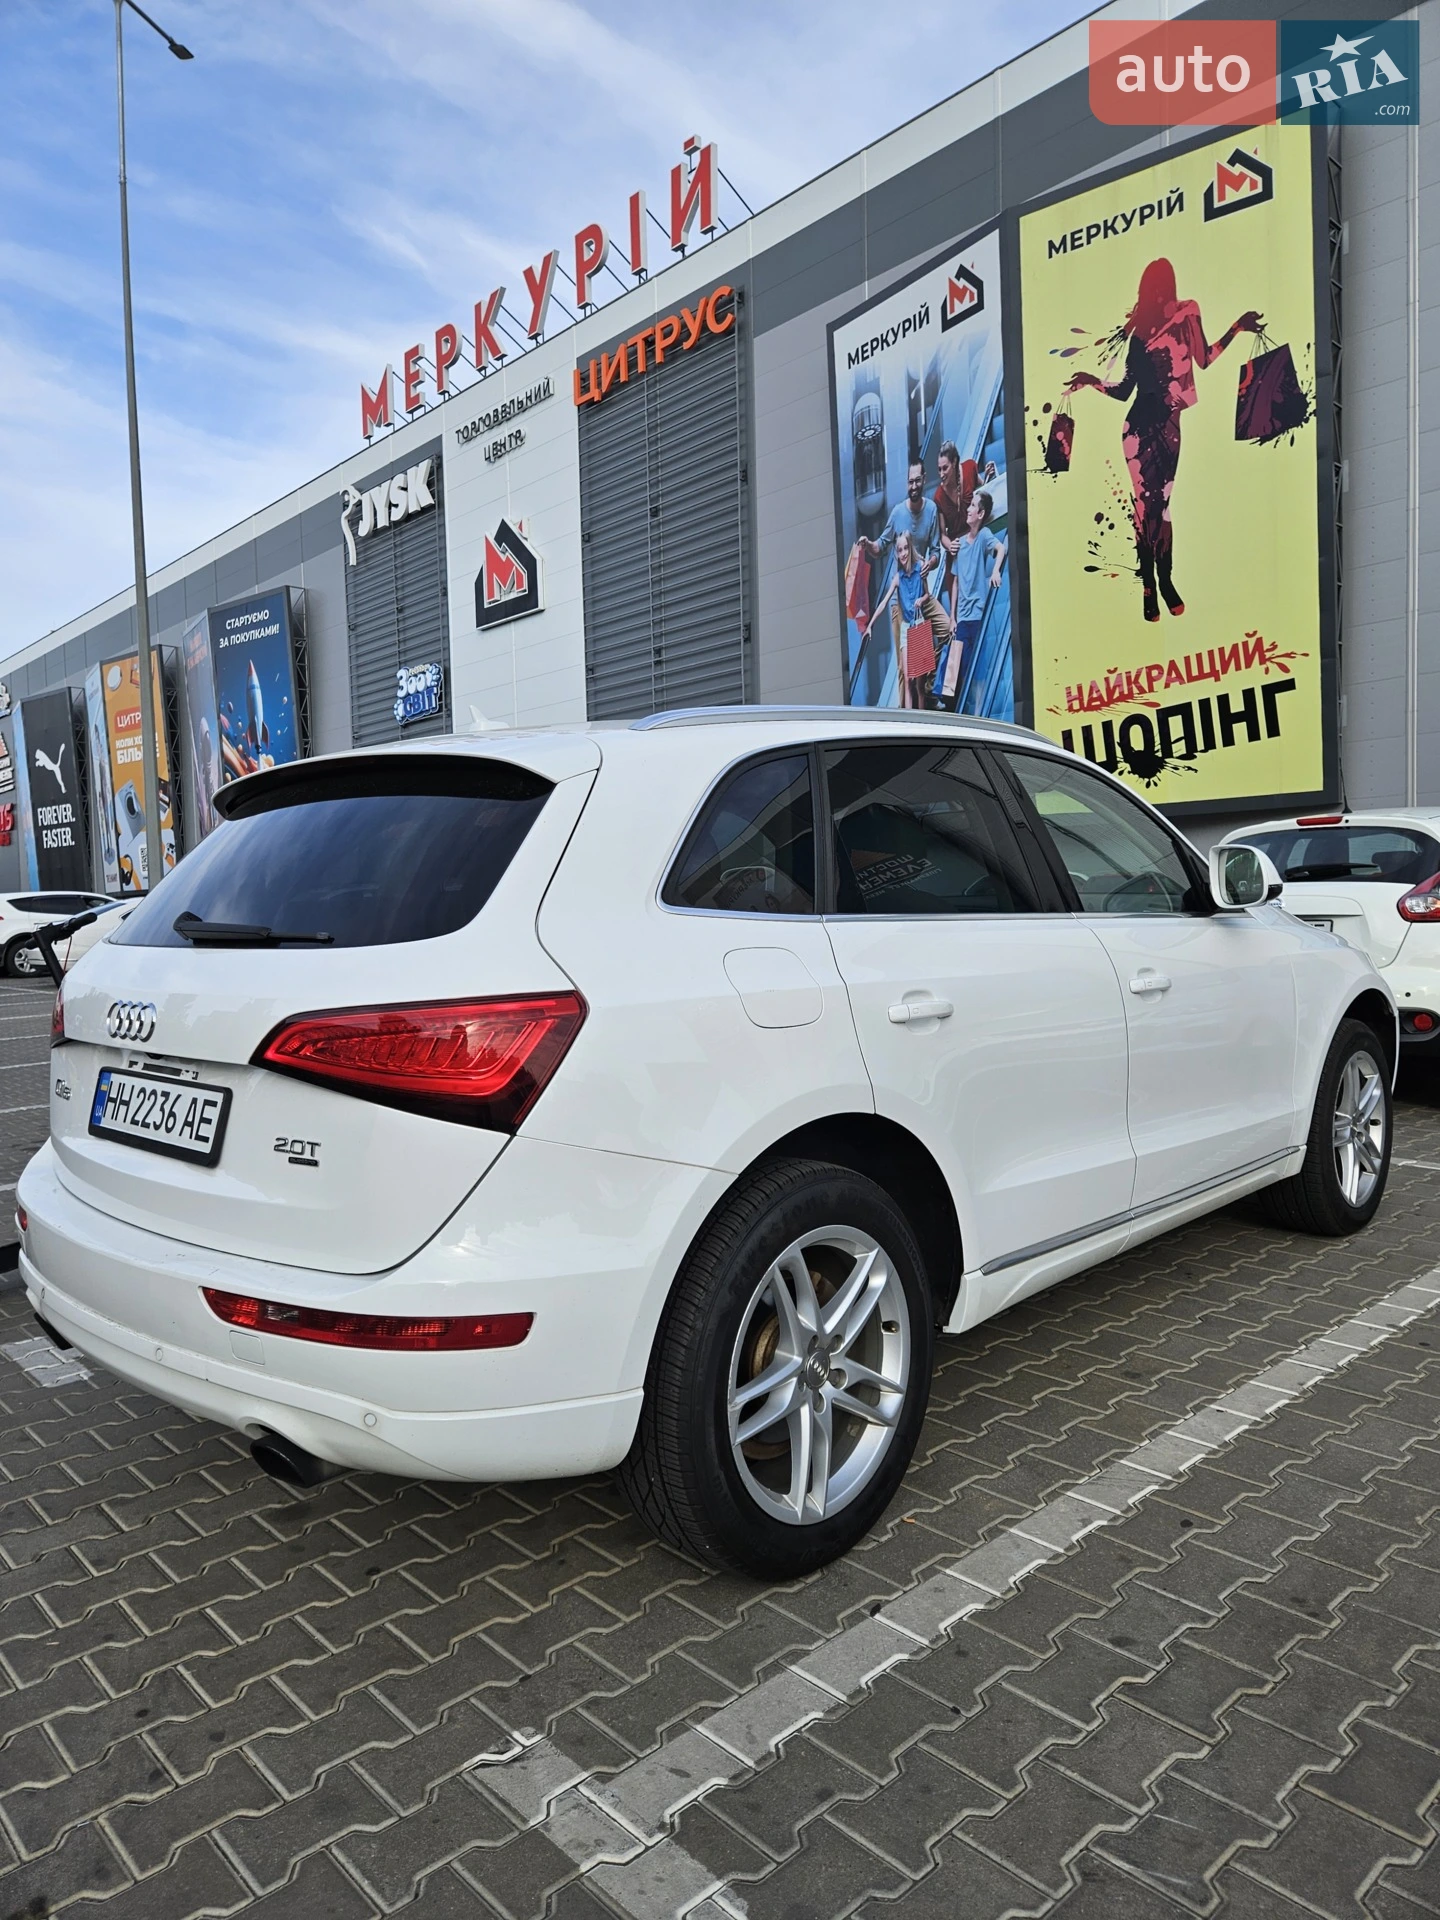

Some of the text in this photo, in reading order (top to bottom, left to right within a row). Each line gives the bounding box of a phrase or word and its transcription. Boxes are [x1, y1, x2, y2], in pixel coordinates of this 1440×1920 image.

[1047, 187, 1185, 260] МЕРКУРІЙ
[361, 134, 718, 440] МЕРКУРІЙ
[573, 285, 736, 407] ЦИТРУС
[847, 301, 930, 370] МЕРКУРІЙ
[455, 376, 552, 445] ТОРГОВЕЛЬНИЙ
[484, 429, 525, 462] ЦЕНТР
[358, 459, 435, 537] JYSK
[219, 623, 280, 649] ЗА ПОКУПКАМИ!
[225, 609, 270, 630] СТАРТУЄМО
[1064, 630, 1268, 713] НАЙКРАЩИЙ
[1061, 677, 1297, 778] ШОПІНГ
[37, 803, 76, 827] FOREVER.
[42, 827, 75, 849] FASTER.
[130, 1086, 182, 1134] 2236
[179, 1097, 218, 1143] AE
